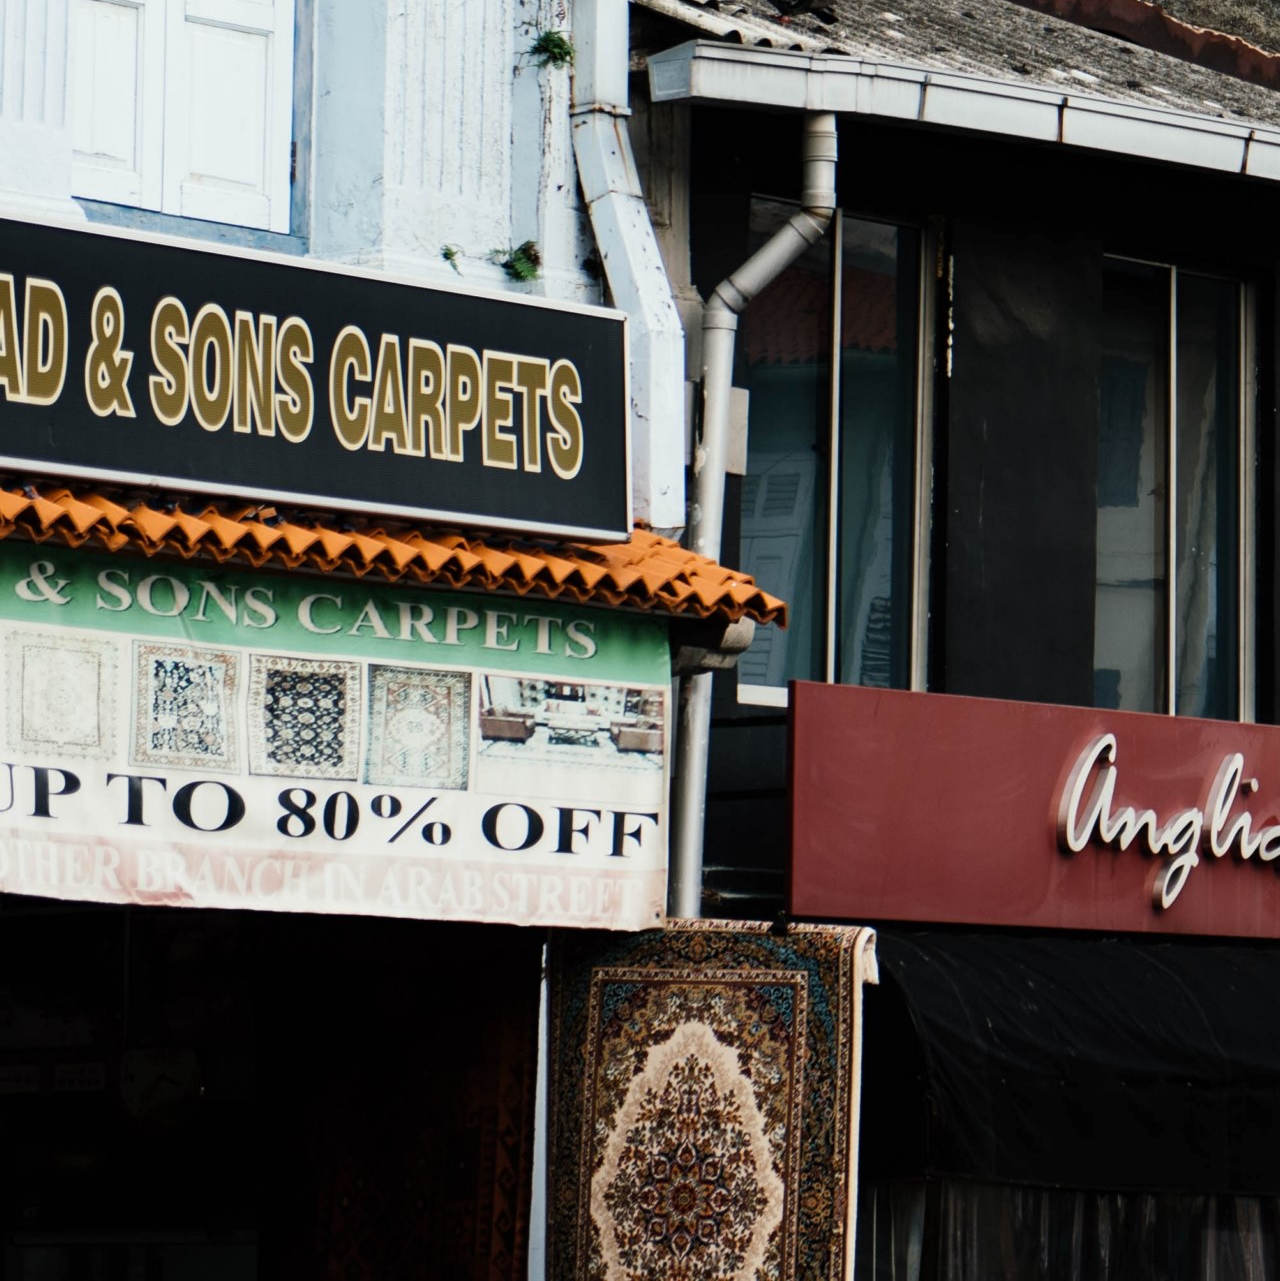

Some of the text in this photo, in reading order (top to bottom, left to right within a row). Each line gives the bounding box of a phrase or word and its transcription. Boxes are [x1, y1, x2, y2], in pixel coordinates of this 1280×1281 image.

[85, 286, 136, 417] &
[149, 296, 314, 443] SONS
[329, 325, 583, 480] CARPETS
[14, 561, 598, 659] & SONS CARPETS
[106, 773, 246, 832] TO
[276, 788, 451, 846] 80%
[482, 802, 659, 857] OFF
[136, 848, 312, 901] BRANCH
[323, 861, 364, 905] IN
[375, 865, 485, 911] ARAB
[491, 870, 643, 918] STREET
